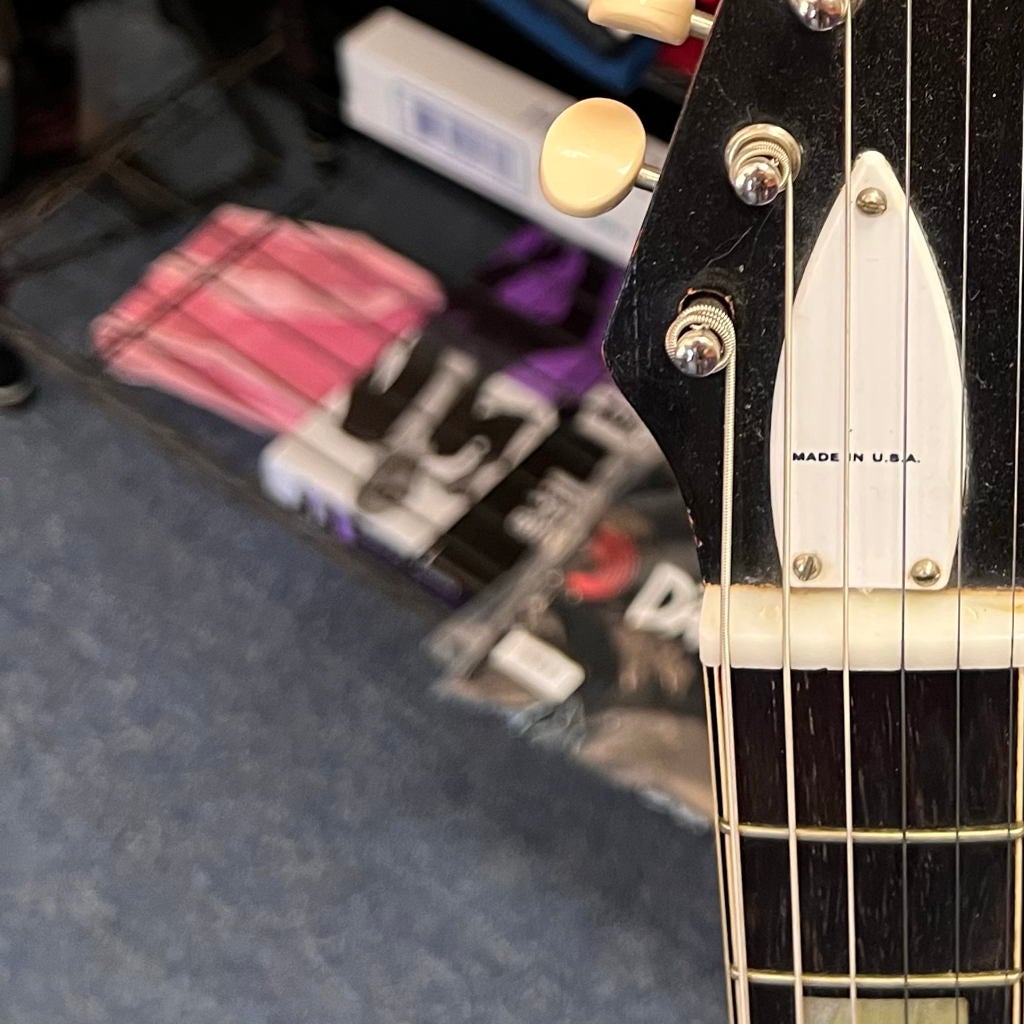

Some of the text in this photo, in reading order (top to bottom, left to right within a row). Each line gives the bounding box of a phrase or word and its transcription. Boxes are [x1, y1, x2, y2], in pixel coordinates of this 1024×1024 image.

[792, 452, 921, 464] MADE IN U.S.A.
